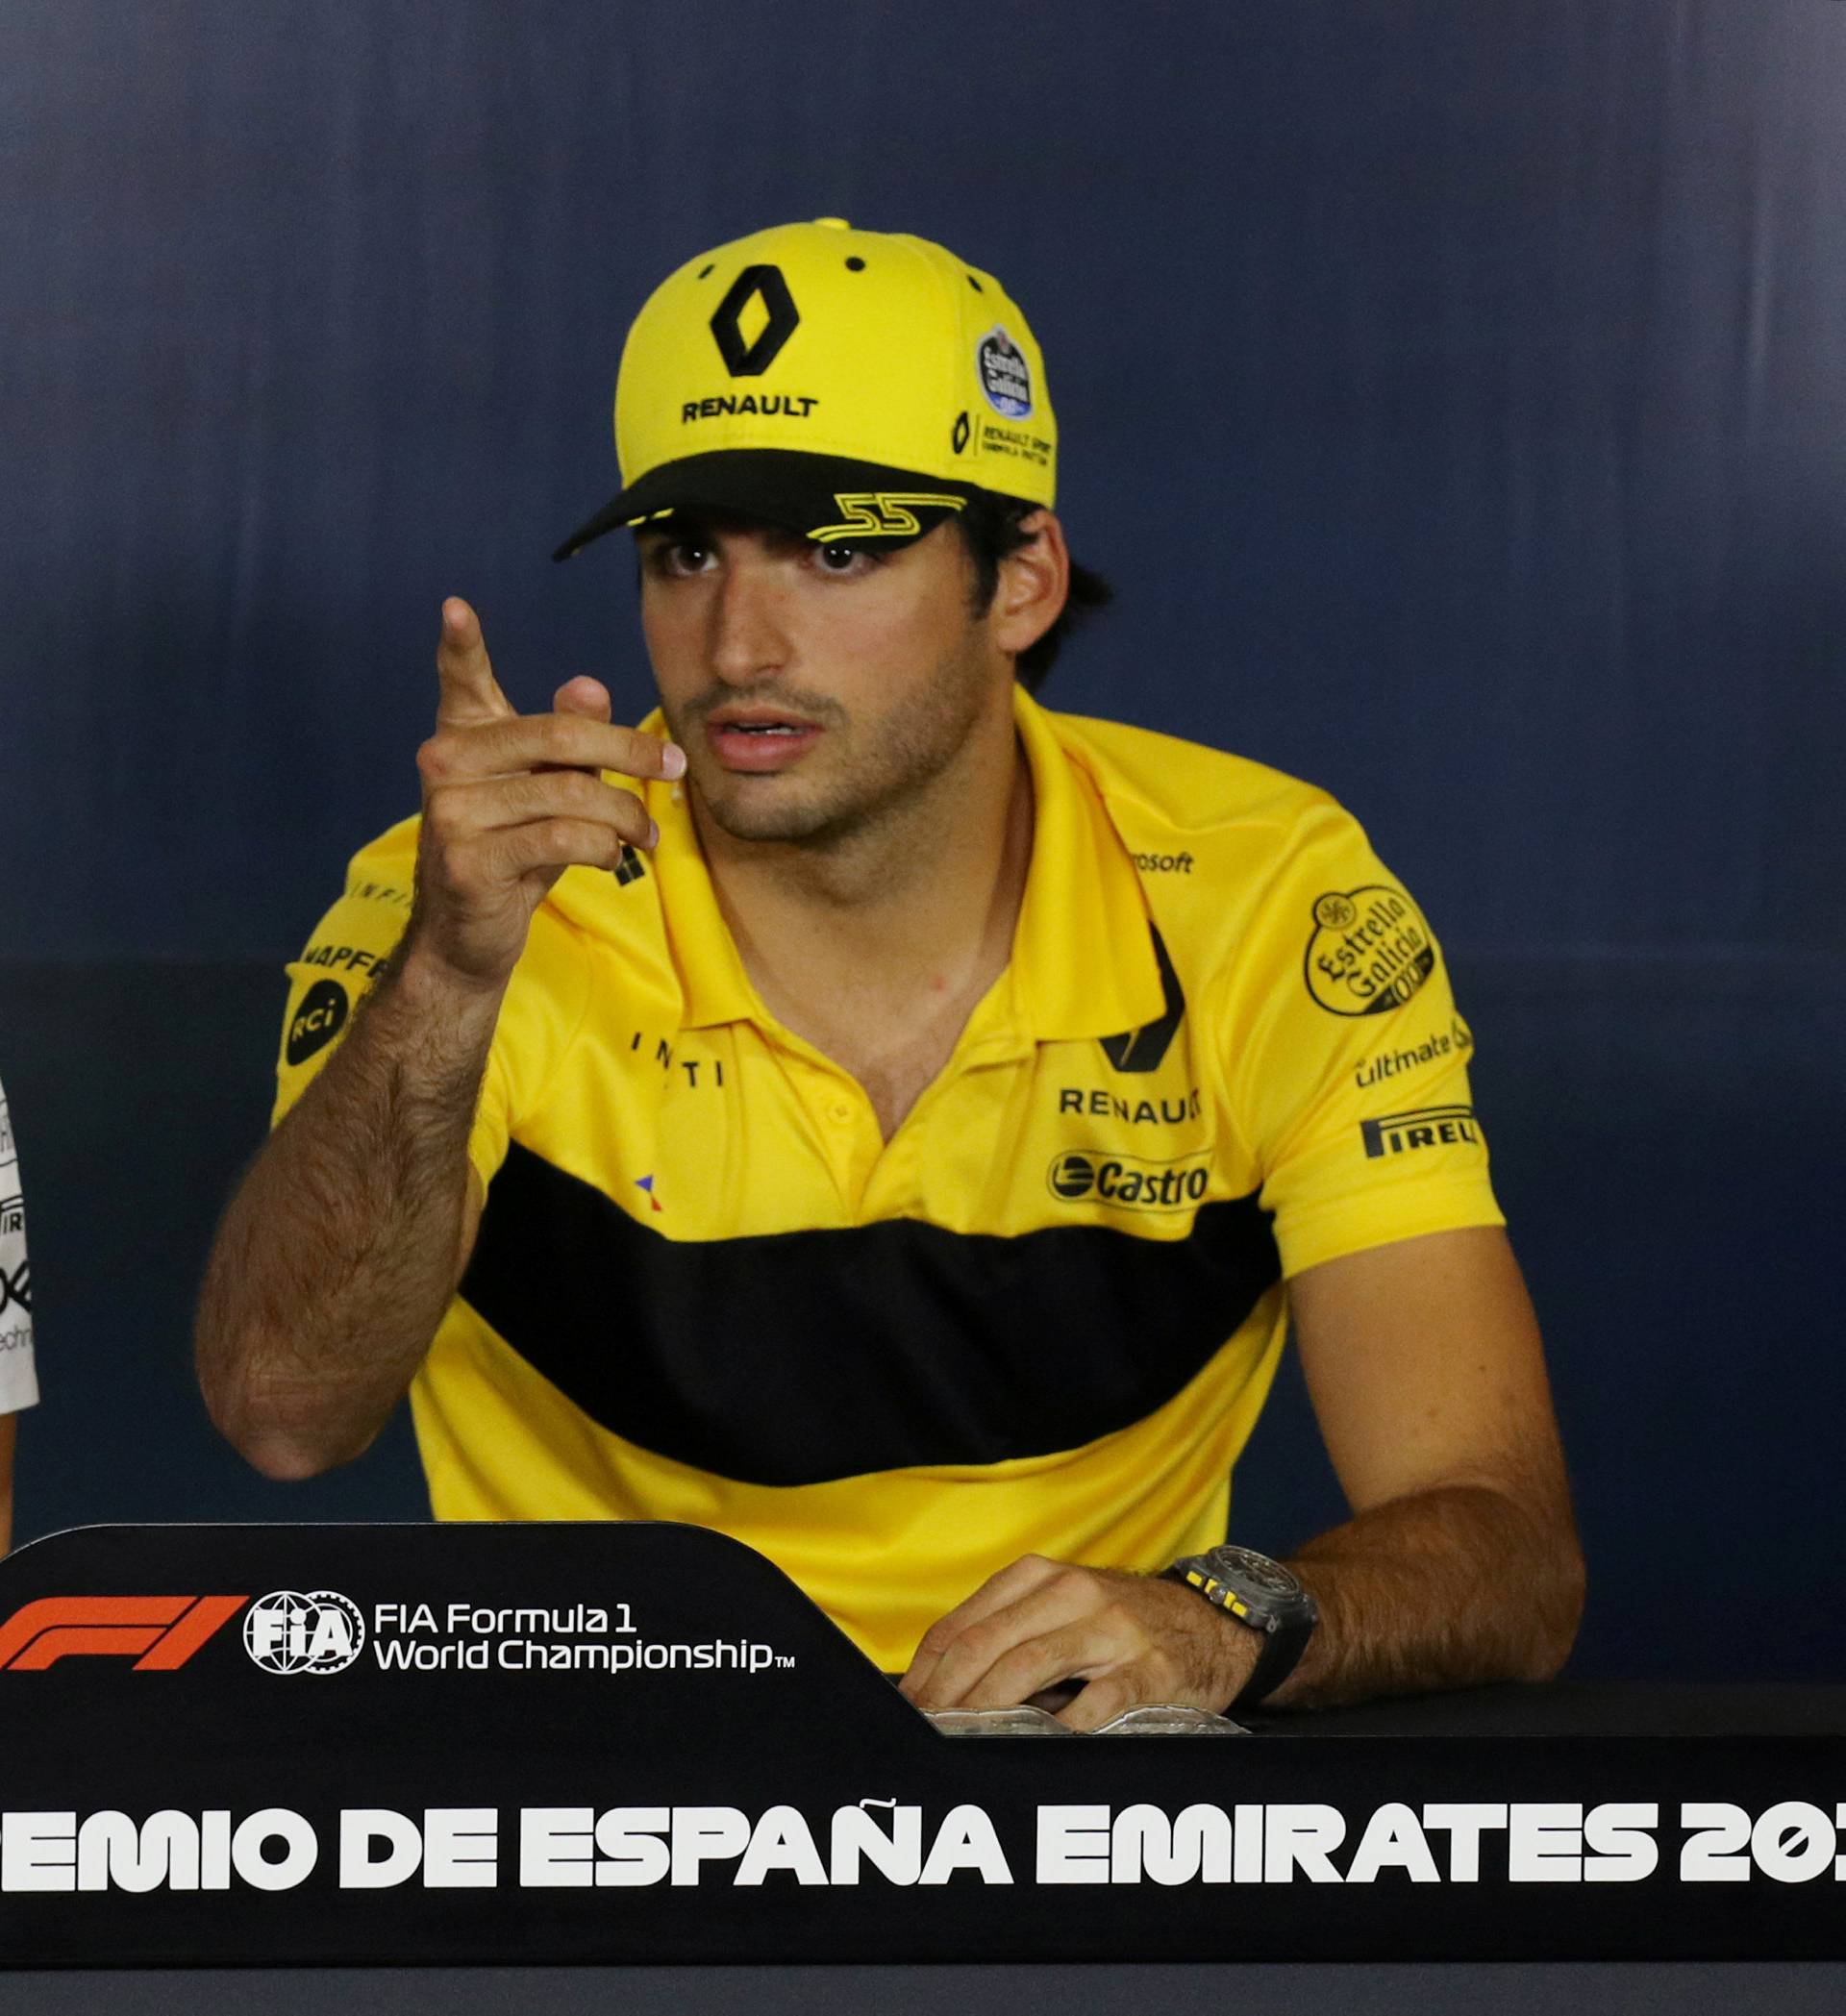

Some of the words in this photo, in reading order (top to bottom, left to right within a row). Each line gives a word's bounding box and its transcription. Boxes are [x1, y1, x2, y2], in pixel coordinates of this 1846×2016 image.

[681, 394, 819, 424] RENAULT
[806, 492, 967, 543] 55
[1317, 897, 1407, 983] Estrella
[1347, 926, 1423, 998] Galicia
[0, 1596, 250, 1671] F1
[374, 1604, 438, 1633] FIA
[447, 1604, 609, 1633] Formula
[615, 1603, 637, 1632] 1
[372, 1639, 489, 1670] World
[497, 1639, 773, 1674] Championship
[0, 1807, 318, 1893] EMIO
[339, 1807, 498, 1889] DE
[519, 1797, 1014, 1887] ESPAÑA
[1035, 1803, 1659, 1886] EMIRATES
